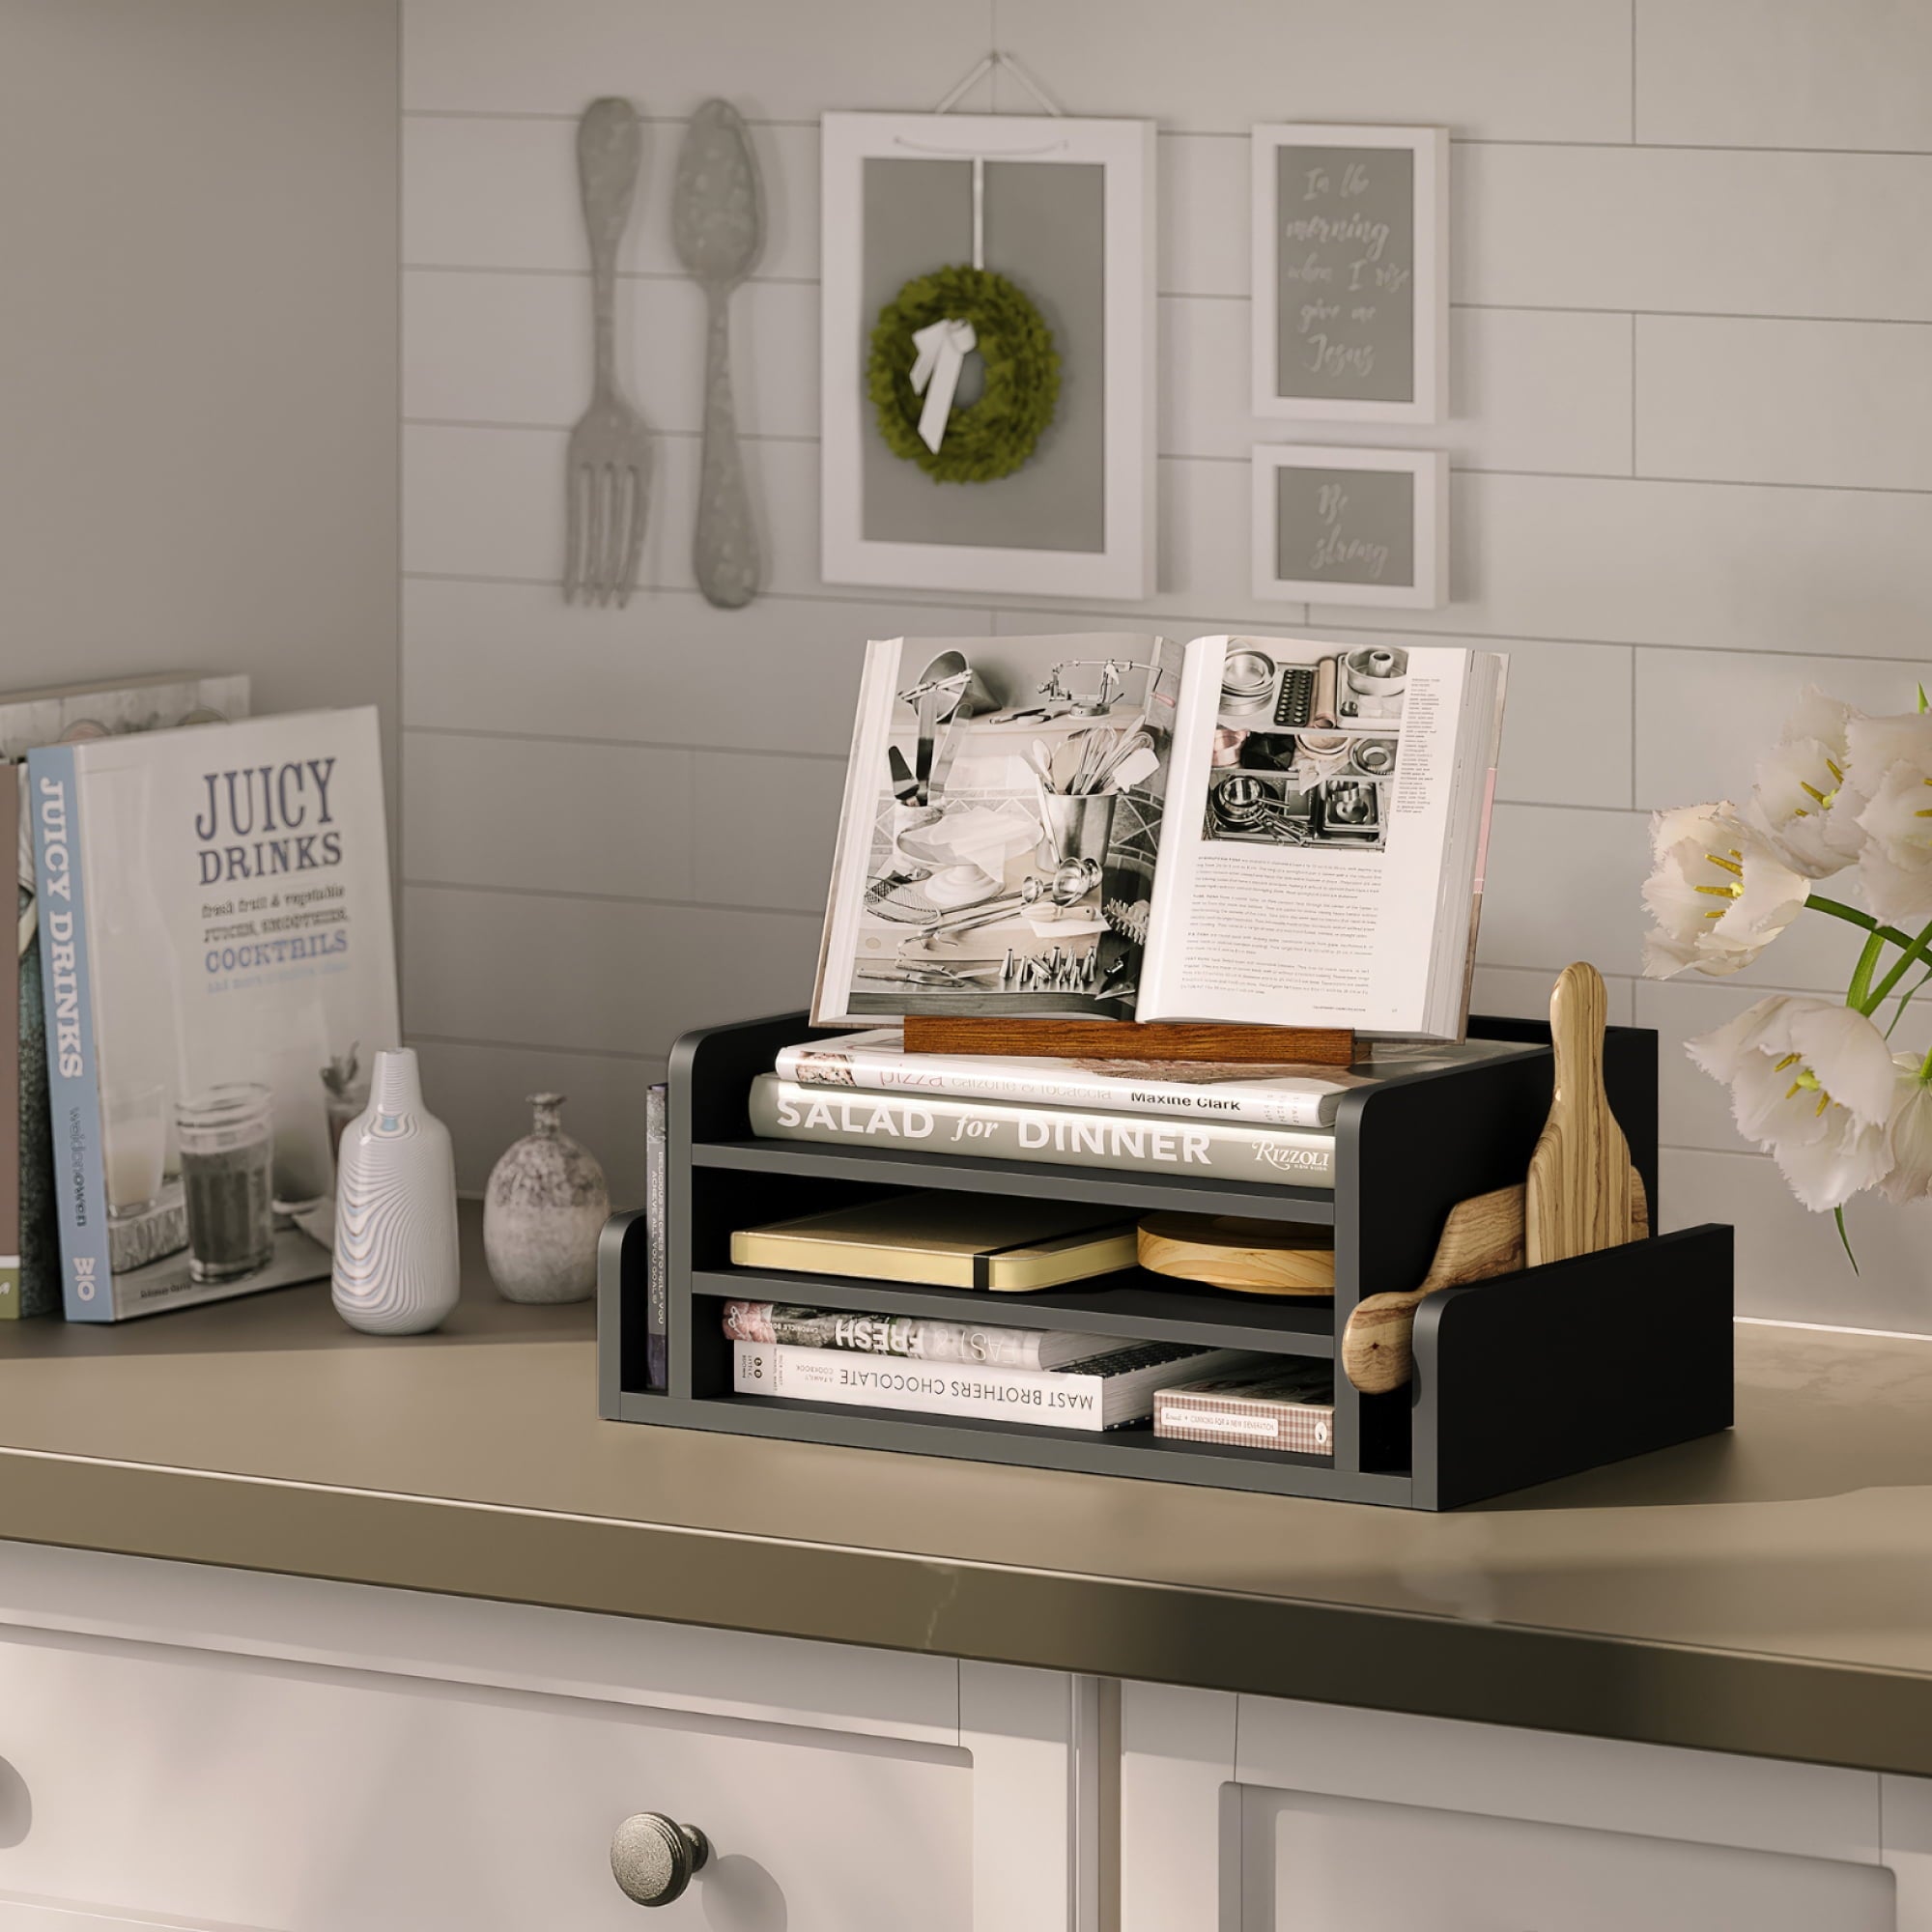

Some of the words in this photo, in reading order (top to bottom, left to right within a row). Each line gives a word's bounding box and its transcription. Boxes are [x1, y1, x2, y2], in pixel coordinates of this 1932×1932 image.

[1286, 212, 1390, 263] morning
[1303, 332, 1375, 378] Jesus
[195, 756, 336, 841] JUICY
[41, 777, 71, 902] JUICY
[197, 831, 343, 886] DRINKS
[205, 928, 348, 974] COCKTAILS
[49, 910, 84, 1080] DRINKS
[878, 1065, 946, 1088] pizza
[1130, 1091, 1192, 1107] Maxine
[1197, 1096, 1241, 1111] Clark
[776, 1096, 935, 1139] SALAD
[950, 1112, 999, 1142] for
[1017, 1114, 1213, 1165] DINNER
[1251, 1139, 1330, 1171] RIZZOLI
[658, 1255, 665, 1269] TO
[835, 1317, 925, 1355] FRESH
[957, 1327, 1016, 1363] FAST
[838, 1368, 945, 1395] CHOCOLATE
[951, 1380, 1042, 1406] BROTHERS
[1048, 1391, 1094, 1410] MAST
